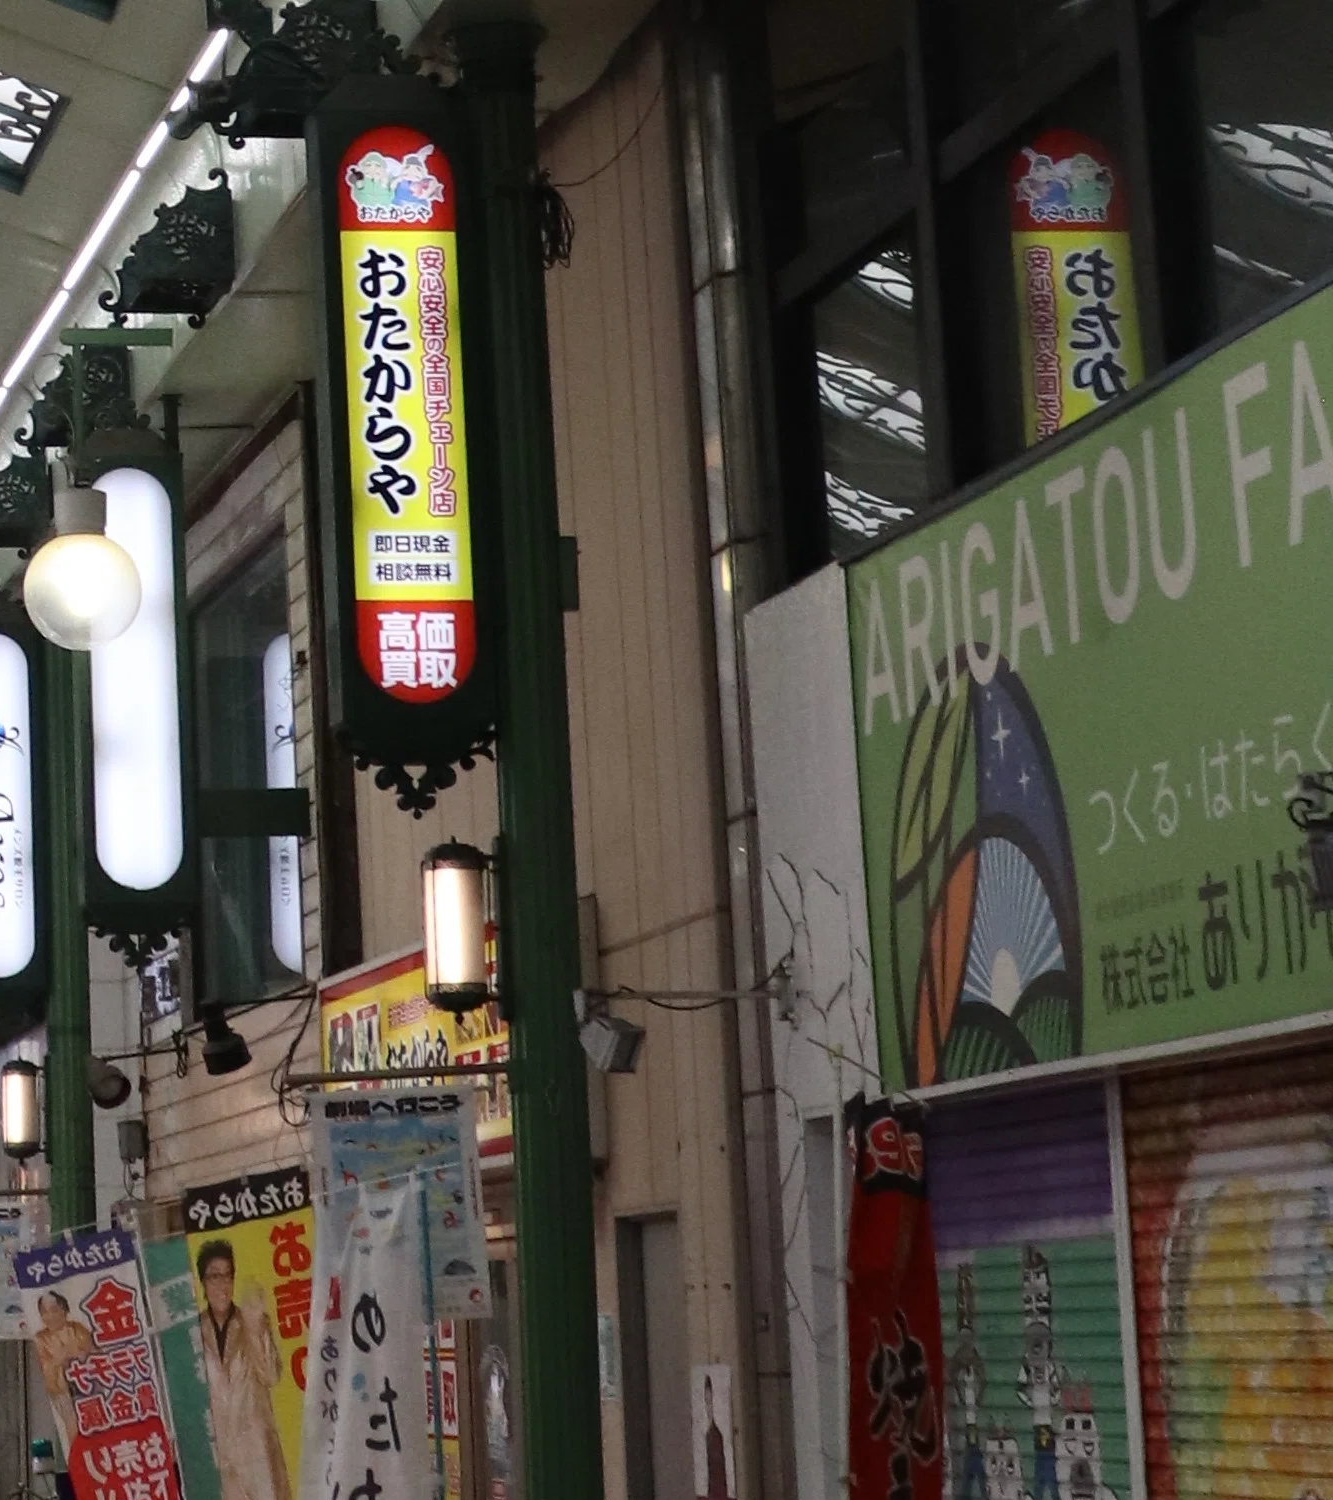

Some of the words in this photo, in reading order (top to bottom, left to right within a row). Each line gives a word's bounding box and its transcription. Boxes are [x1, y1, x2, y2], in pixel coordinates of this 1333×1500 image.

[359, 205, 431, 220] おたからや
[359, 249, 417, 514] おたからや
[419, 247, 455, 516] 安心安全の全国チェーン店
[375, 535, 451, 554] 即日現金
[376, 563, 452, 582] 相談無料
[862, 407, 1198, 738] ARIGATOU
[377, 612, 455, 650] 高価
[380, 651, 457, 688] 買取
[1100, 925, 1195, 1015] 株式会社
